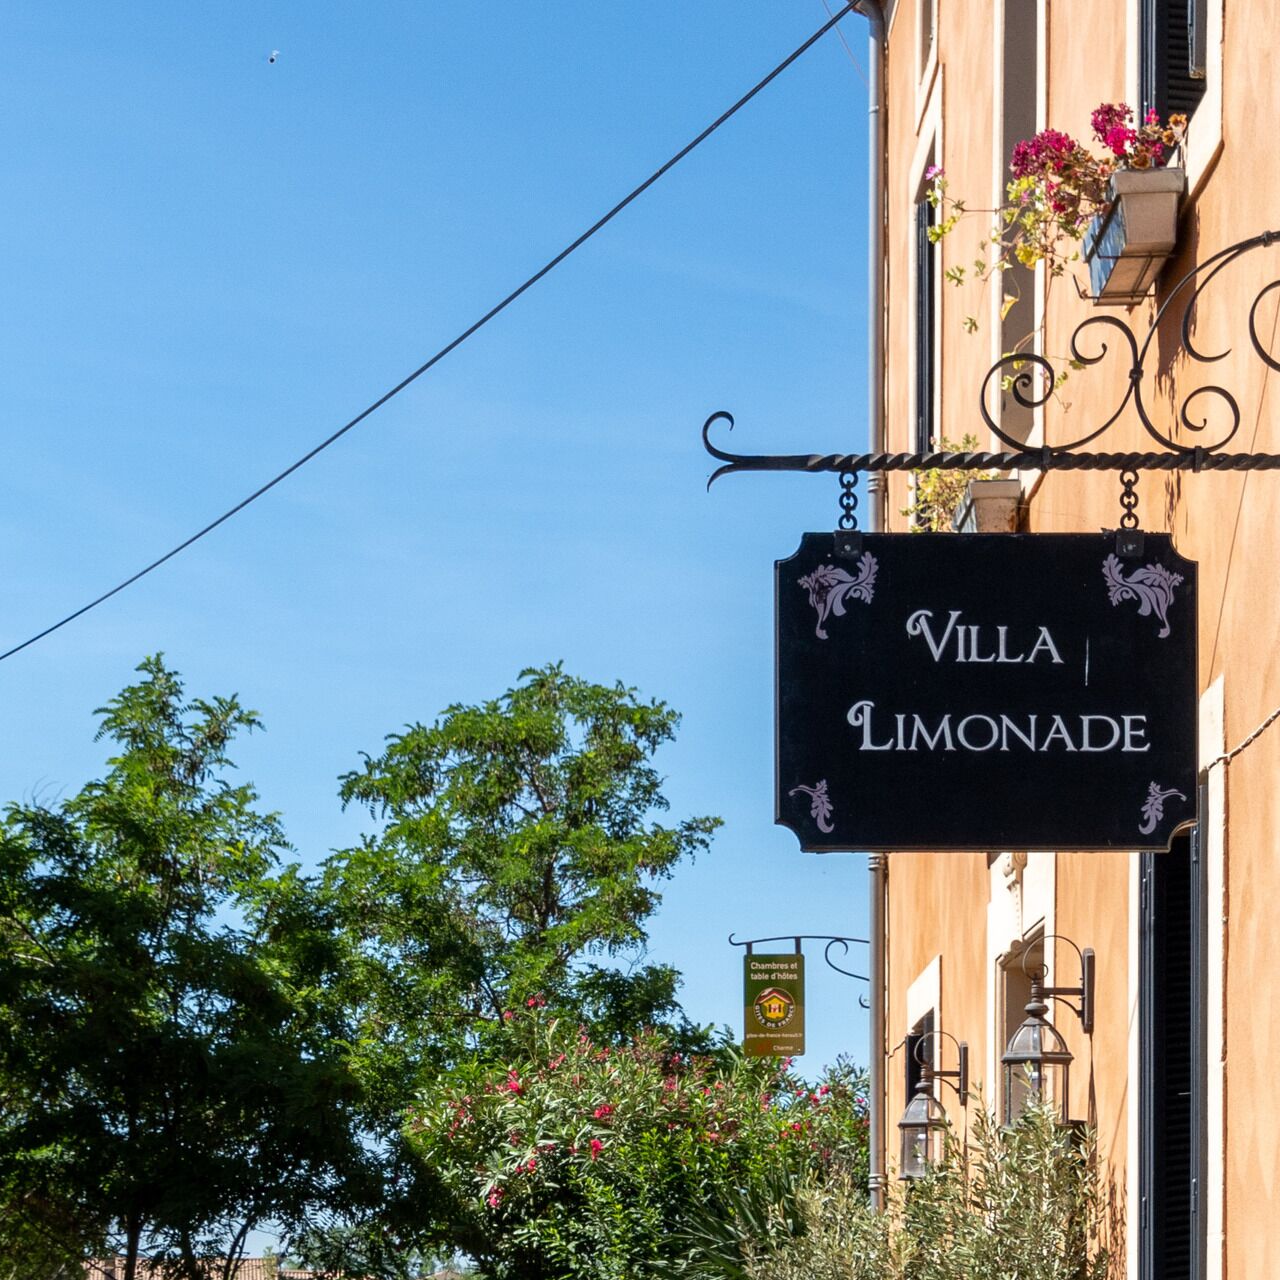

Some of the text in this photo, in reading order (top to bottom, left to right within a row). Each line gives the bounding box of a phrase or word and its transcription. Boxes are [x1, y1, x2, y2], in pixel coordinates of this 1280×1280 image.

[750, 961, 798, 970] Chambres et
[750, 972, 798, 980] table d'hôtes
